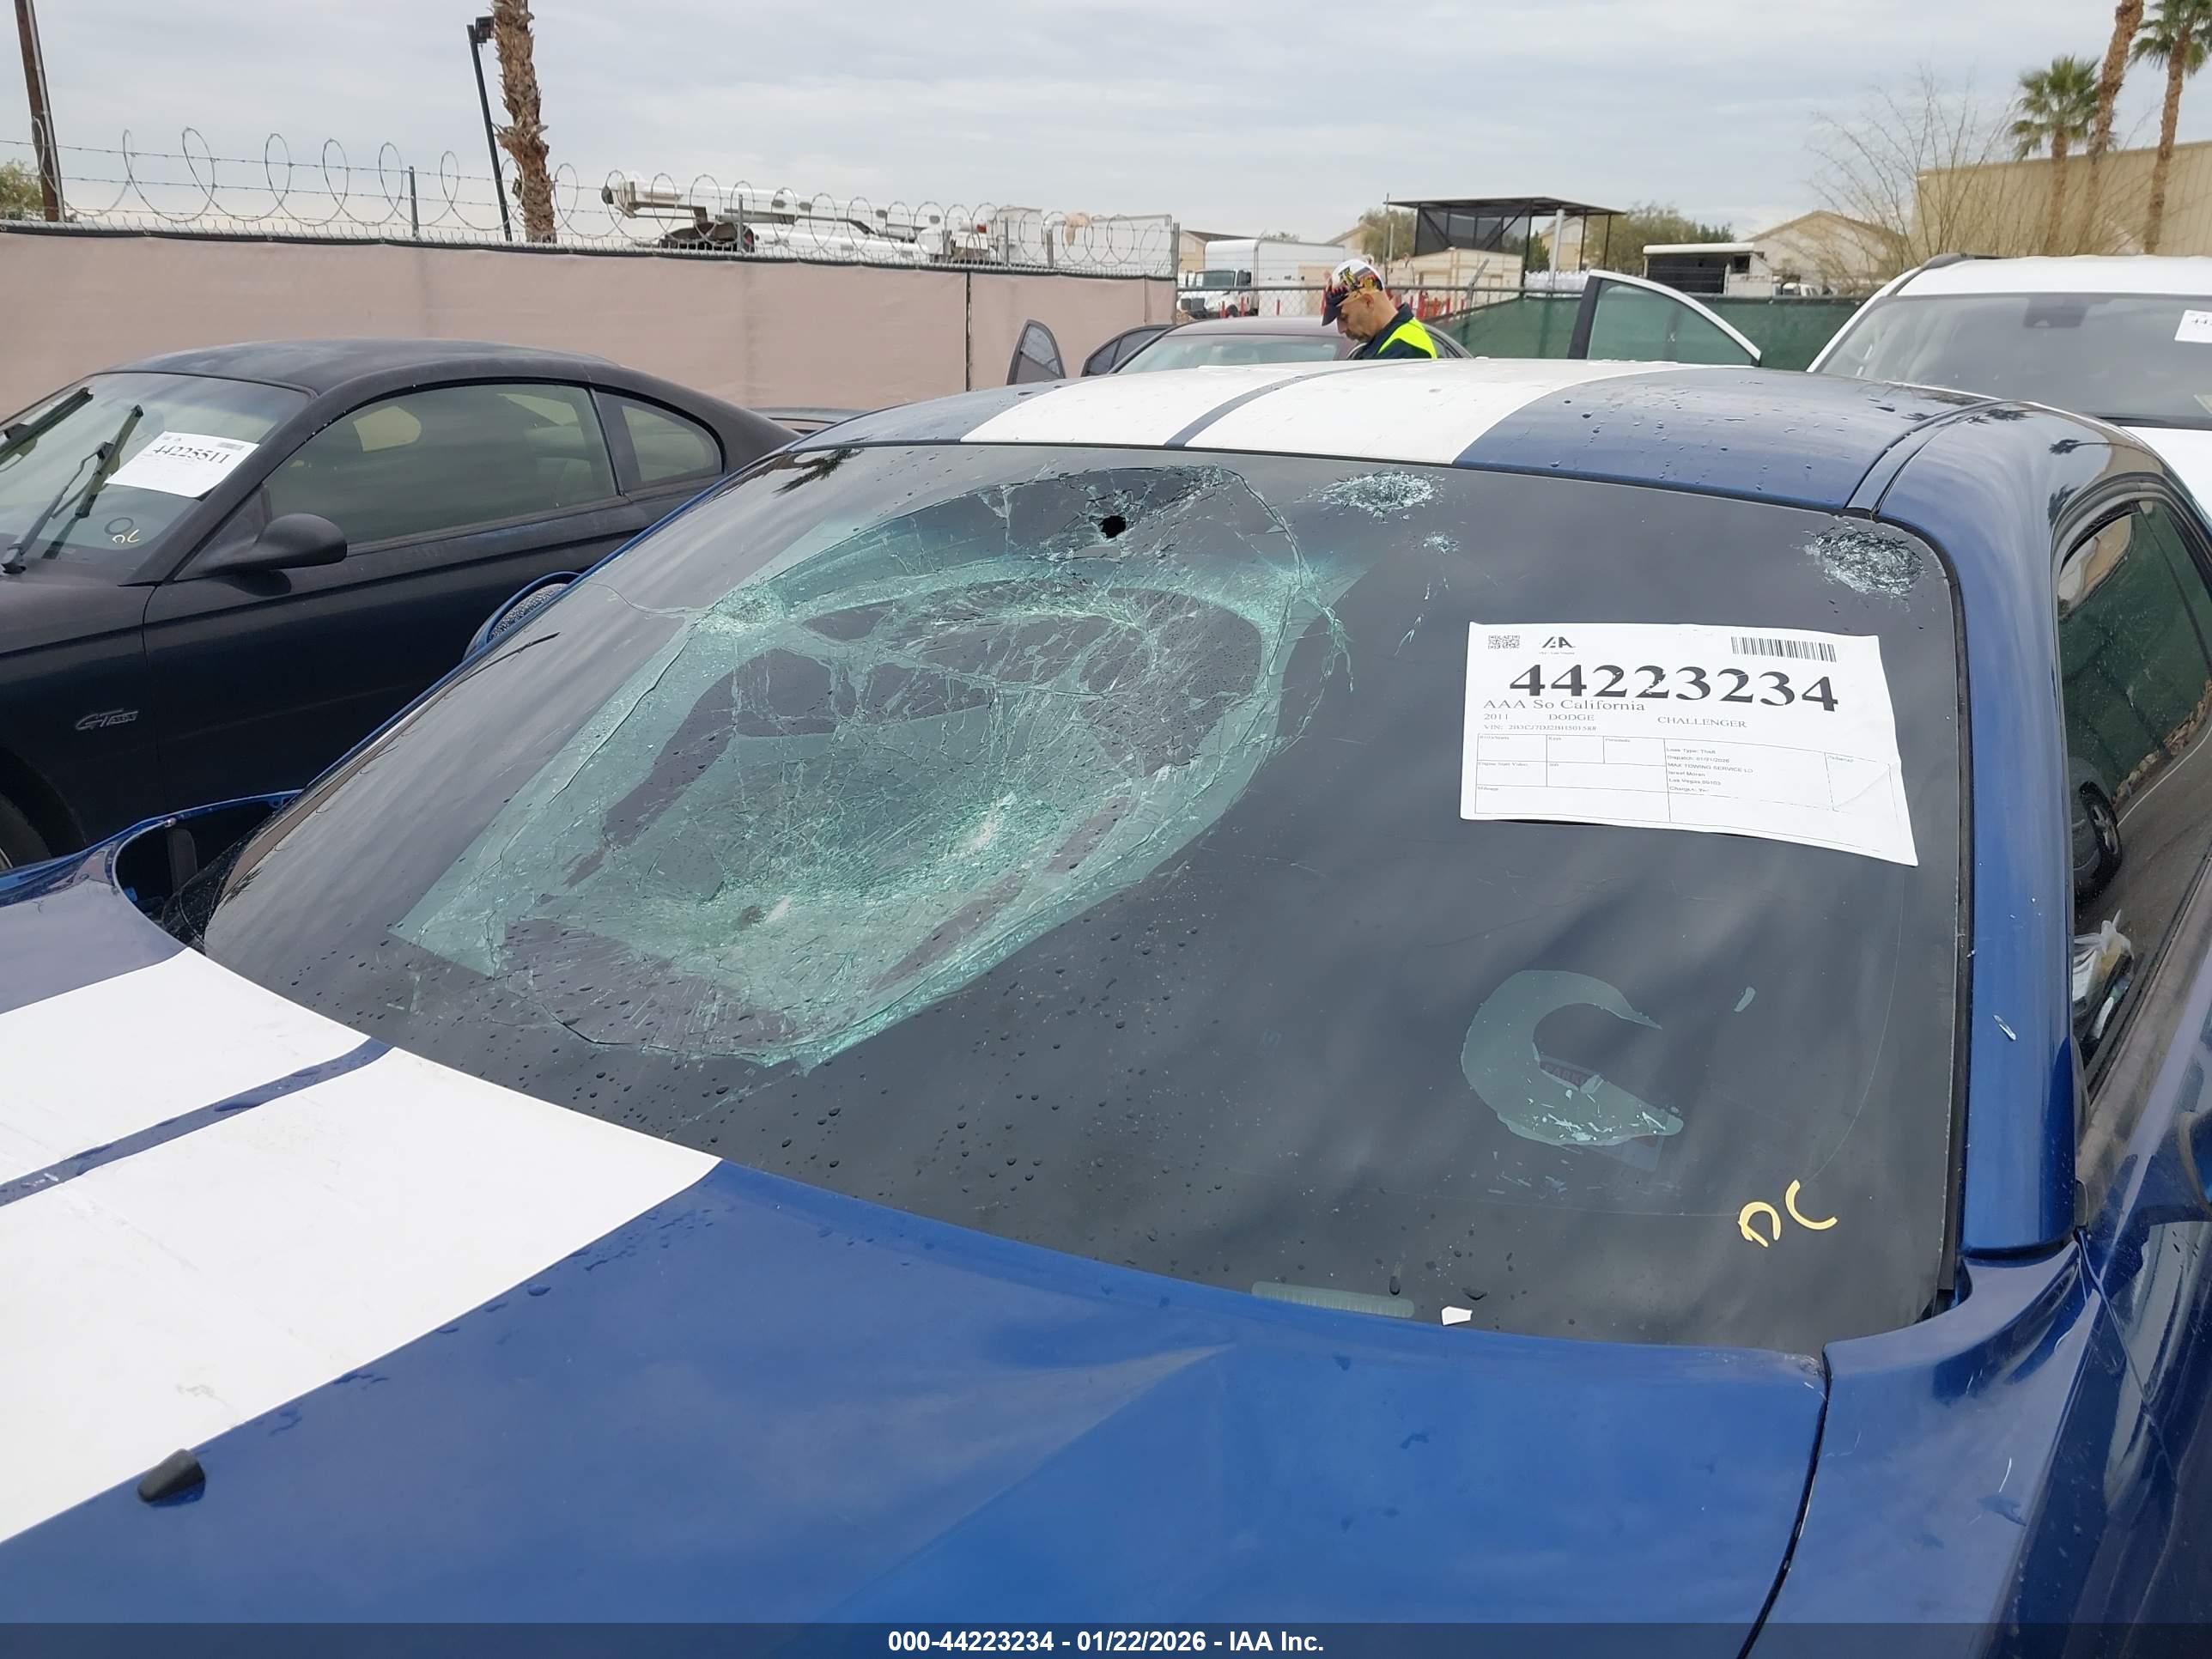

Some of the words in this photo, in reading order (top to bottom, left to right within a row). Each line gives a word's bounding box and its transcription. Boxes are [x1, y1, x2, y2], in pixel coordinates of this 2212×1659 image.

[152, 444, 231, 464] 44225511
[1509, 664, 1838, 712] 44223234
[1483, 699, 1526, 709] AAA
[1533, 699, 1555, 710] So
[1560, 699, 1646, 711] California
[1484, 713, 1509, 721] 2011
[1548, 714, 1595, 722] DODGE
[1657, 715, 1747, 728] CHALLENGER
